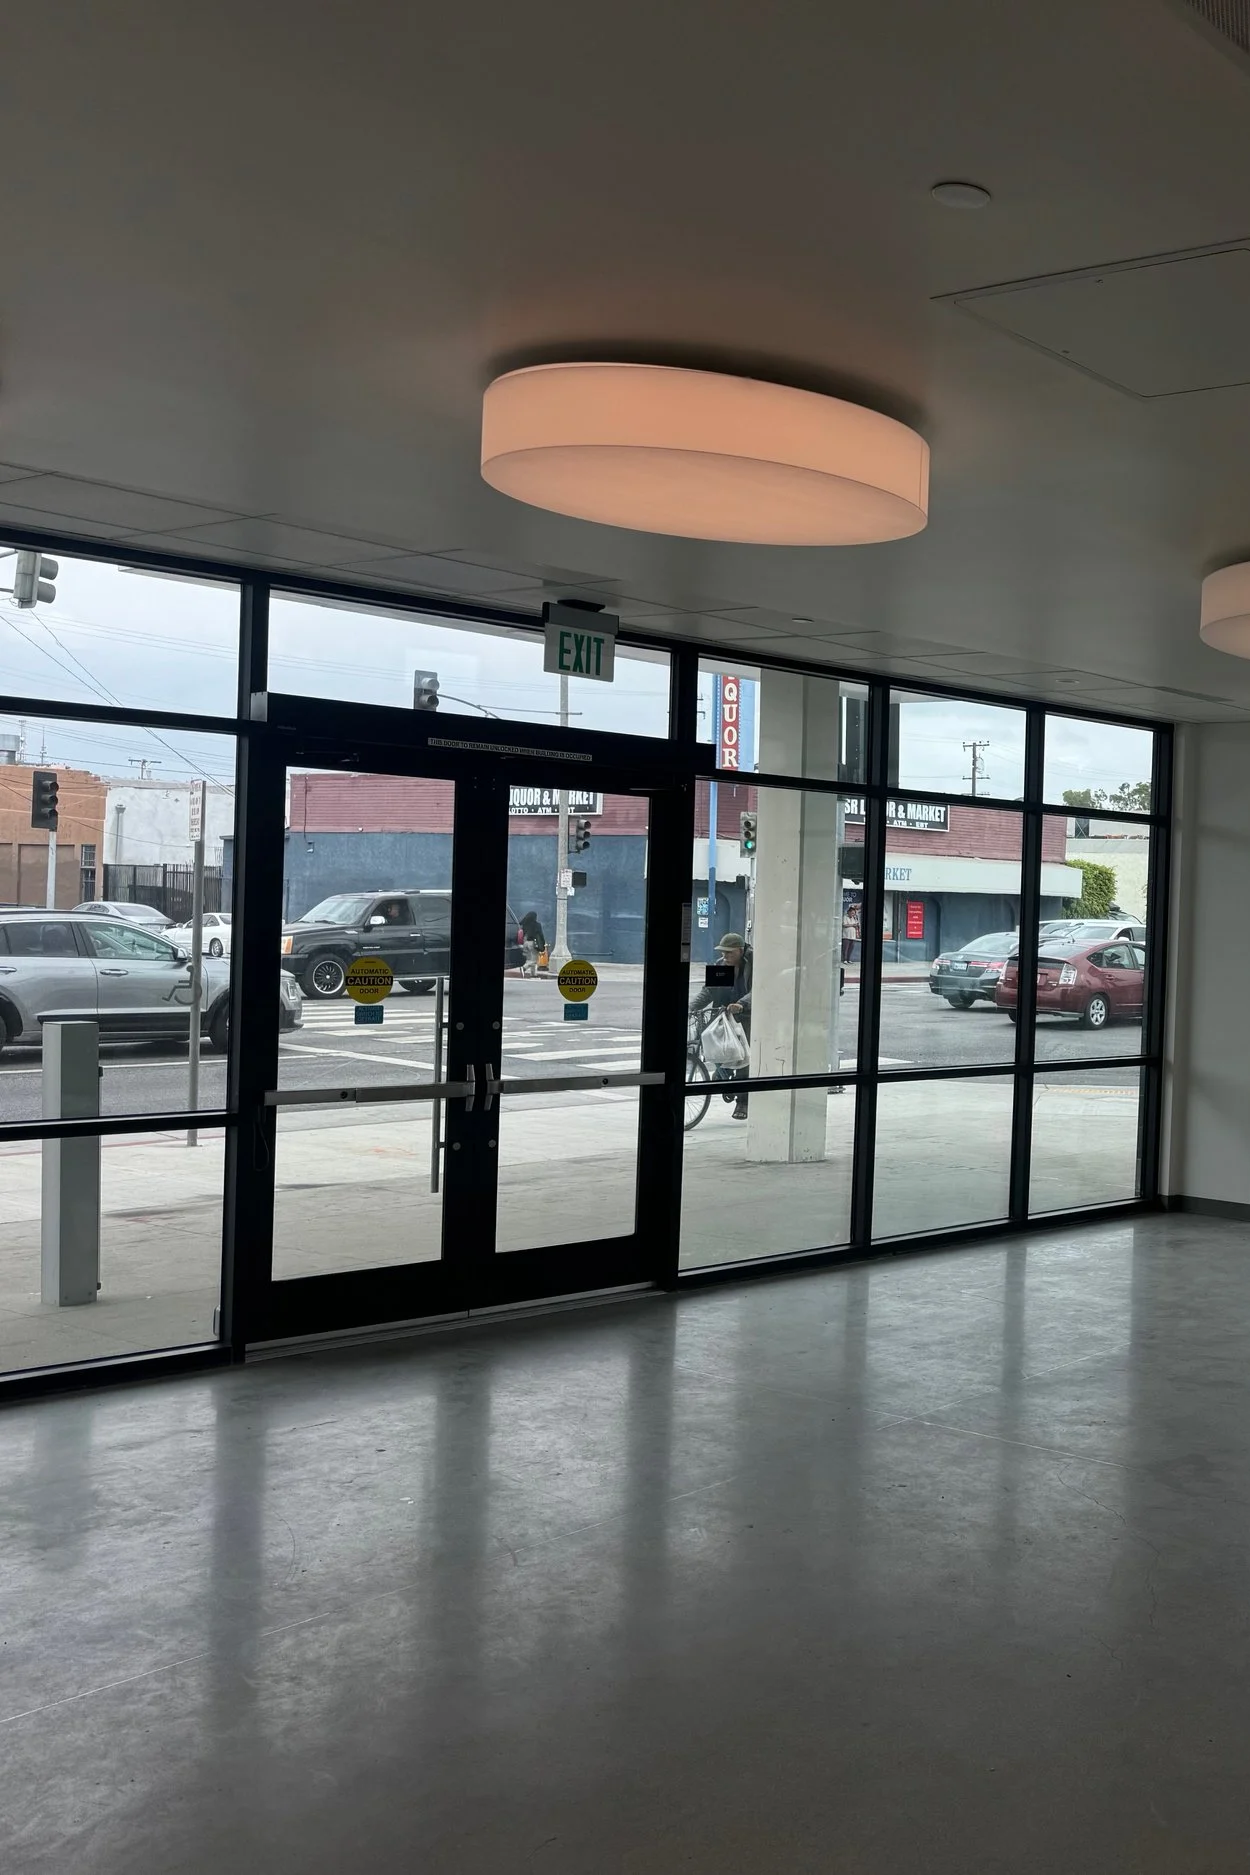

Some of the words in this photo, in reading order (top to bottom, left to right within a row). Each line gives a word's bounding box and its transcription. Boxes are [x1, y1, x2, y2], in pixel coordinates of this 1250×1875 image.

[558, 630, 605, 676] EXIT
[722, 676, 739, 768] QUOR
[509, 788, 541, 806] IQUOR
[552, 789, 594, 805] MRKET
[907, 803, 946, 822] MARKET
[884, 867, 912, 881] RKET
[347, 976, 392, 985] CAUTION
[560, 977, 597, 985] CAUTION
